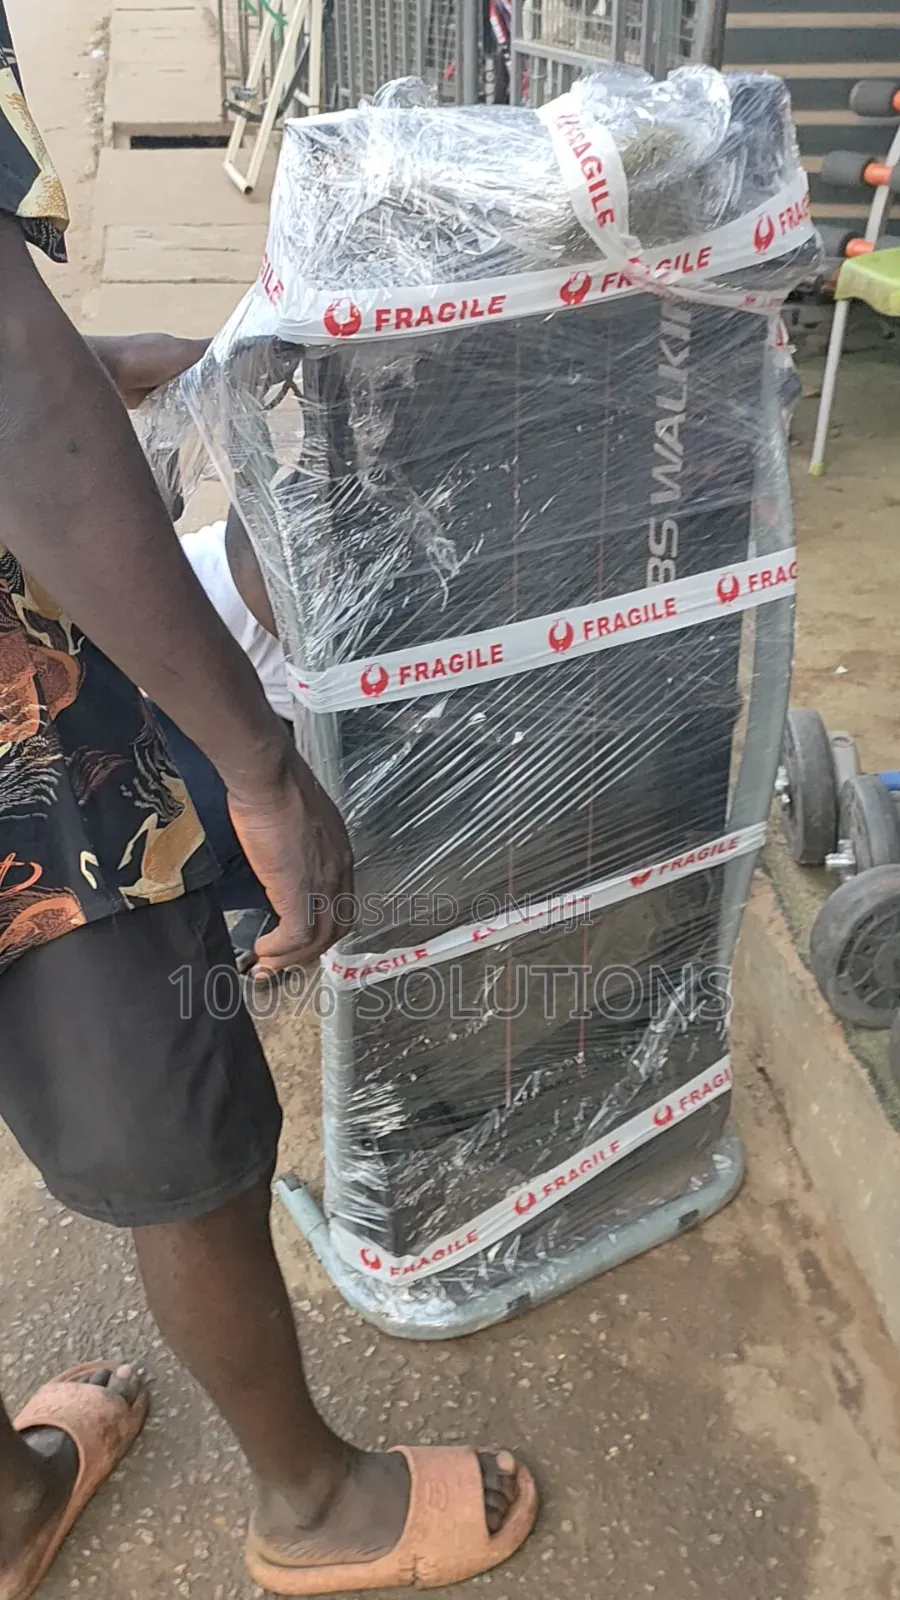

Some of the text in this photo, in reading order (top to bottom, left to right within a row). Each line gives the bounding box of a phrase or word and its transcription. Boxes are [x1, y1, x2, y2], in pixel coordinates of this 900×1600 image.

[600, 246, 713, 293] FRGILE
[374, 294, 507, 332] FRAGILE
[399, 642, 504, 686] FRAGILE
[582, 596, 678, 641] FRAGILE
[332, 836, 741, 980] FRAGILE FRAGILE
[542, 1140, 621, 1197] FRAGILE
